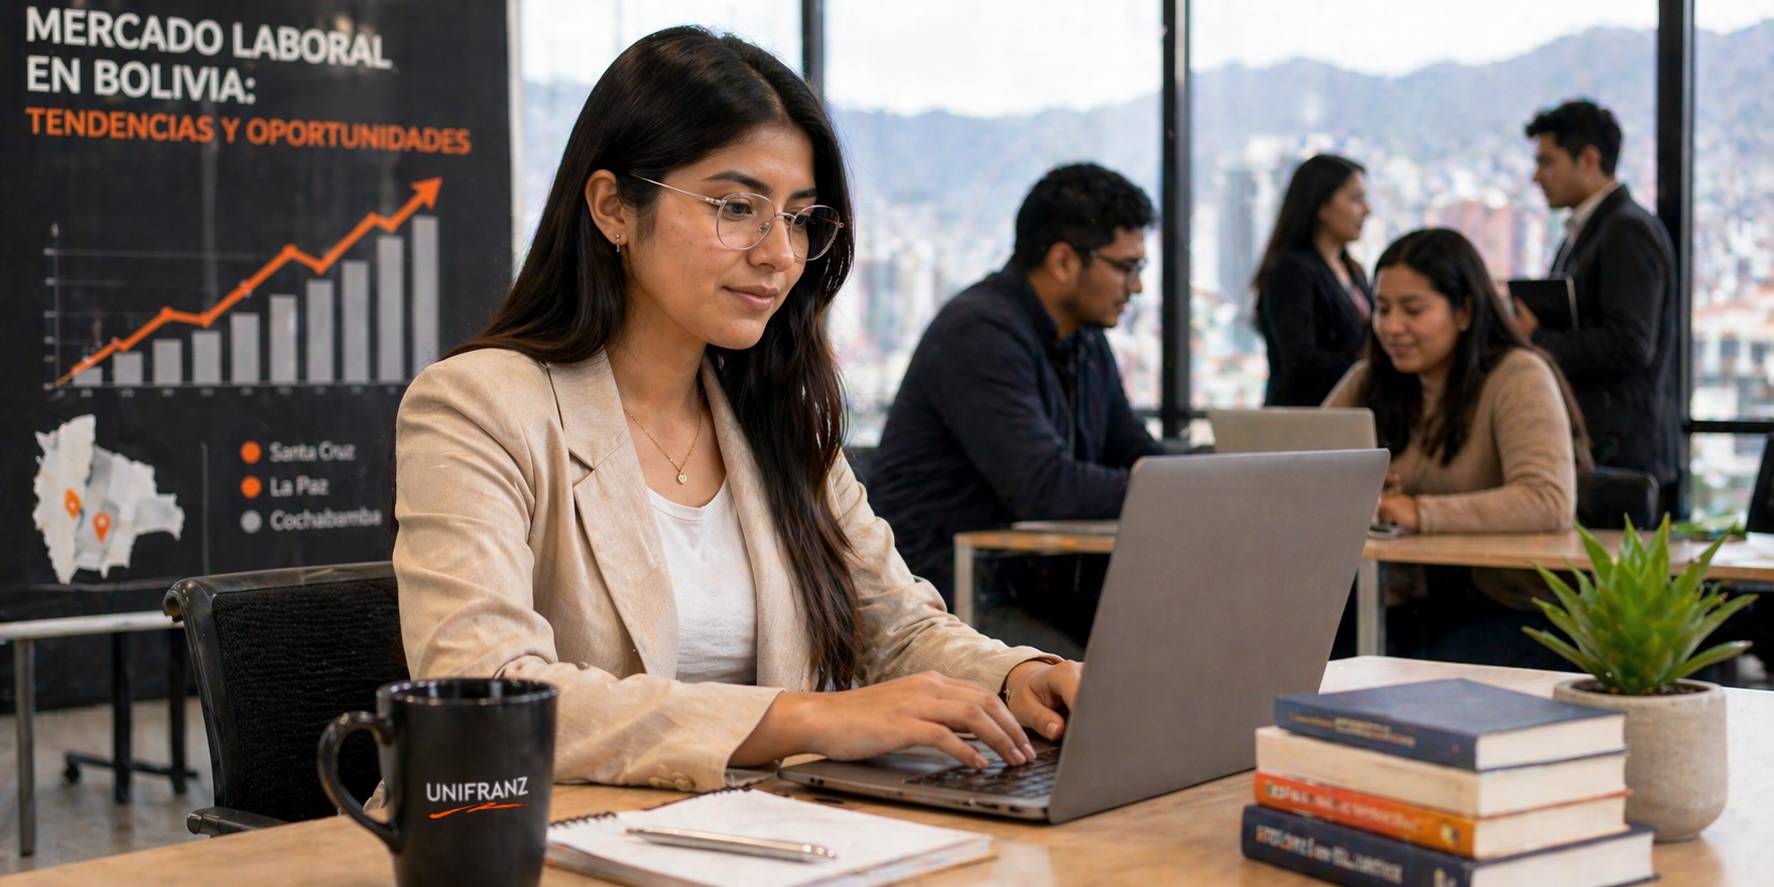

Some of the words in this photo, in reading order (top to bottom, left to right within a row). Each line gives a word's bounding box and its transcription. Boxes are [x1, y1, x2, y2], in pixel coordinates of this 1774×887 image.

[26, 7, 223, 56] MERCADO
[233, 23, 393, 69] LABORAL
[27, 56, 80, 94] EN
[94, 60, 256, 104] BOLIVIA:
[25, 107, 214, 142] TENDENCIAS
[220, 118, 241, 144] Y
[246, 119, 471, 155] OPORTUNIDADES
[269, 441, 317, 462] Santa
[318, 440, 356, 461] Cruz
[270, 476, 293, 497] La
[296, 475, 329, 496] Paz
[270, 506, 382, 531] Cochabamba
[426, 776, 528, 802] UNIFRANZ
